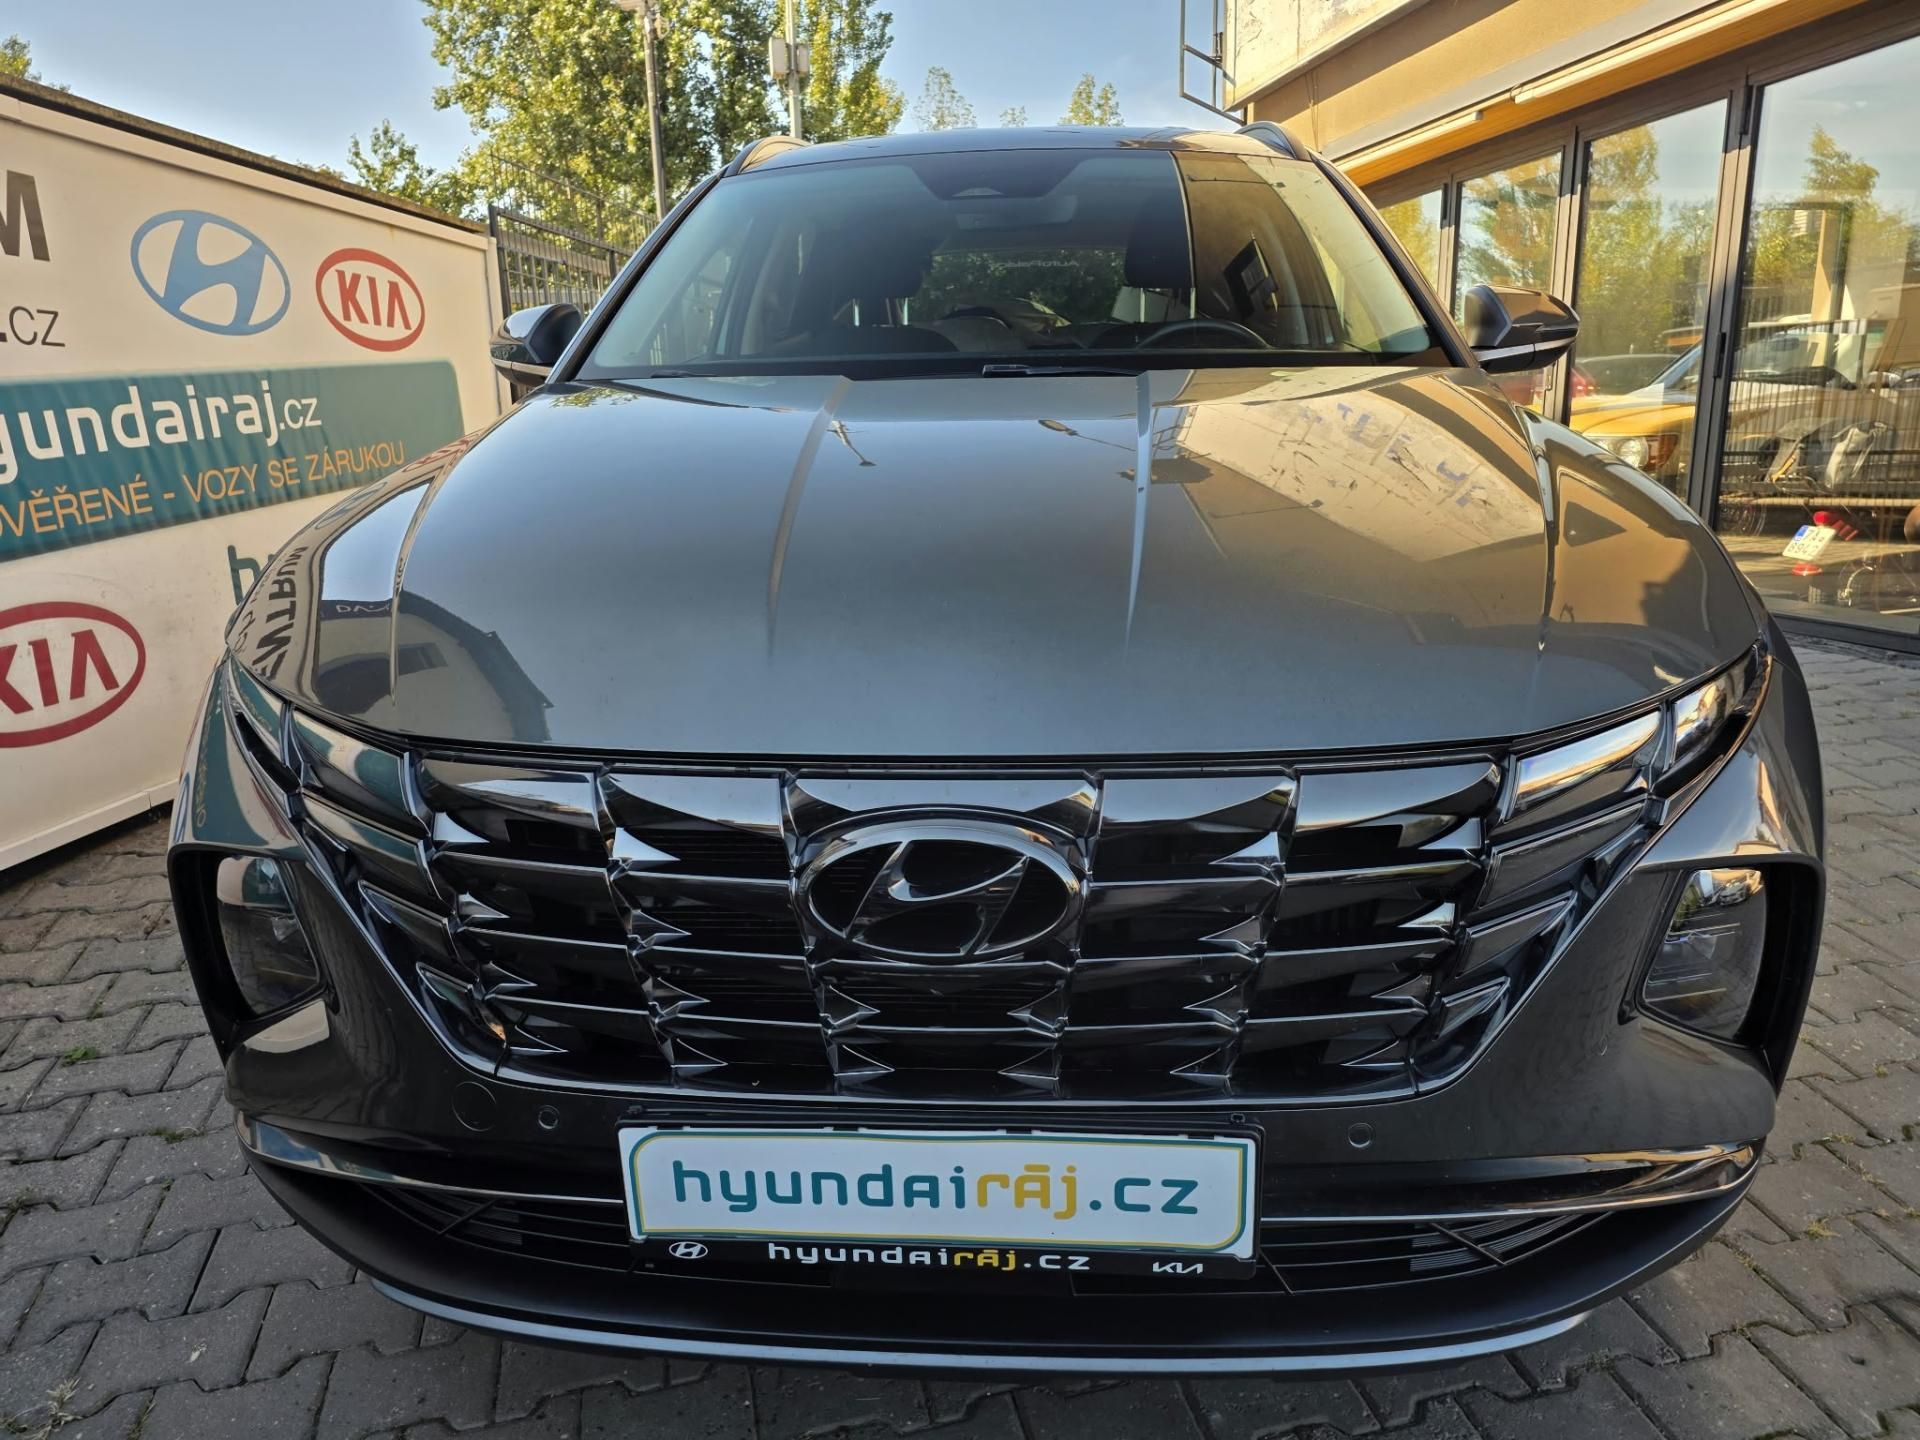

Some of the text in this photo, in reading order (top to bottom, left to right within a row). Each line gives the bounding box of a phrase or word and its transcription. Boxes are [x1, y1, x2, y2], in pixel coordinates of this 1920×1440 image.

[335, 269, 412, 331] KIA
[0, 473, 153, 537] VĚŘENÉ
[182, 463, 258, 502] VOZY
[267, 456, 300, 488] SE
[304, 440, 406, 481] ZÁRUKOU
